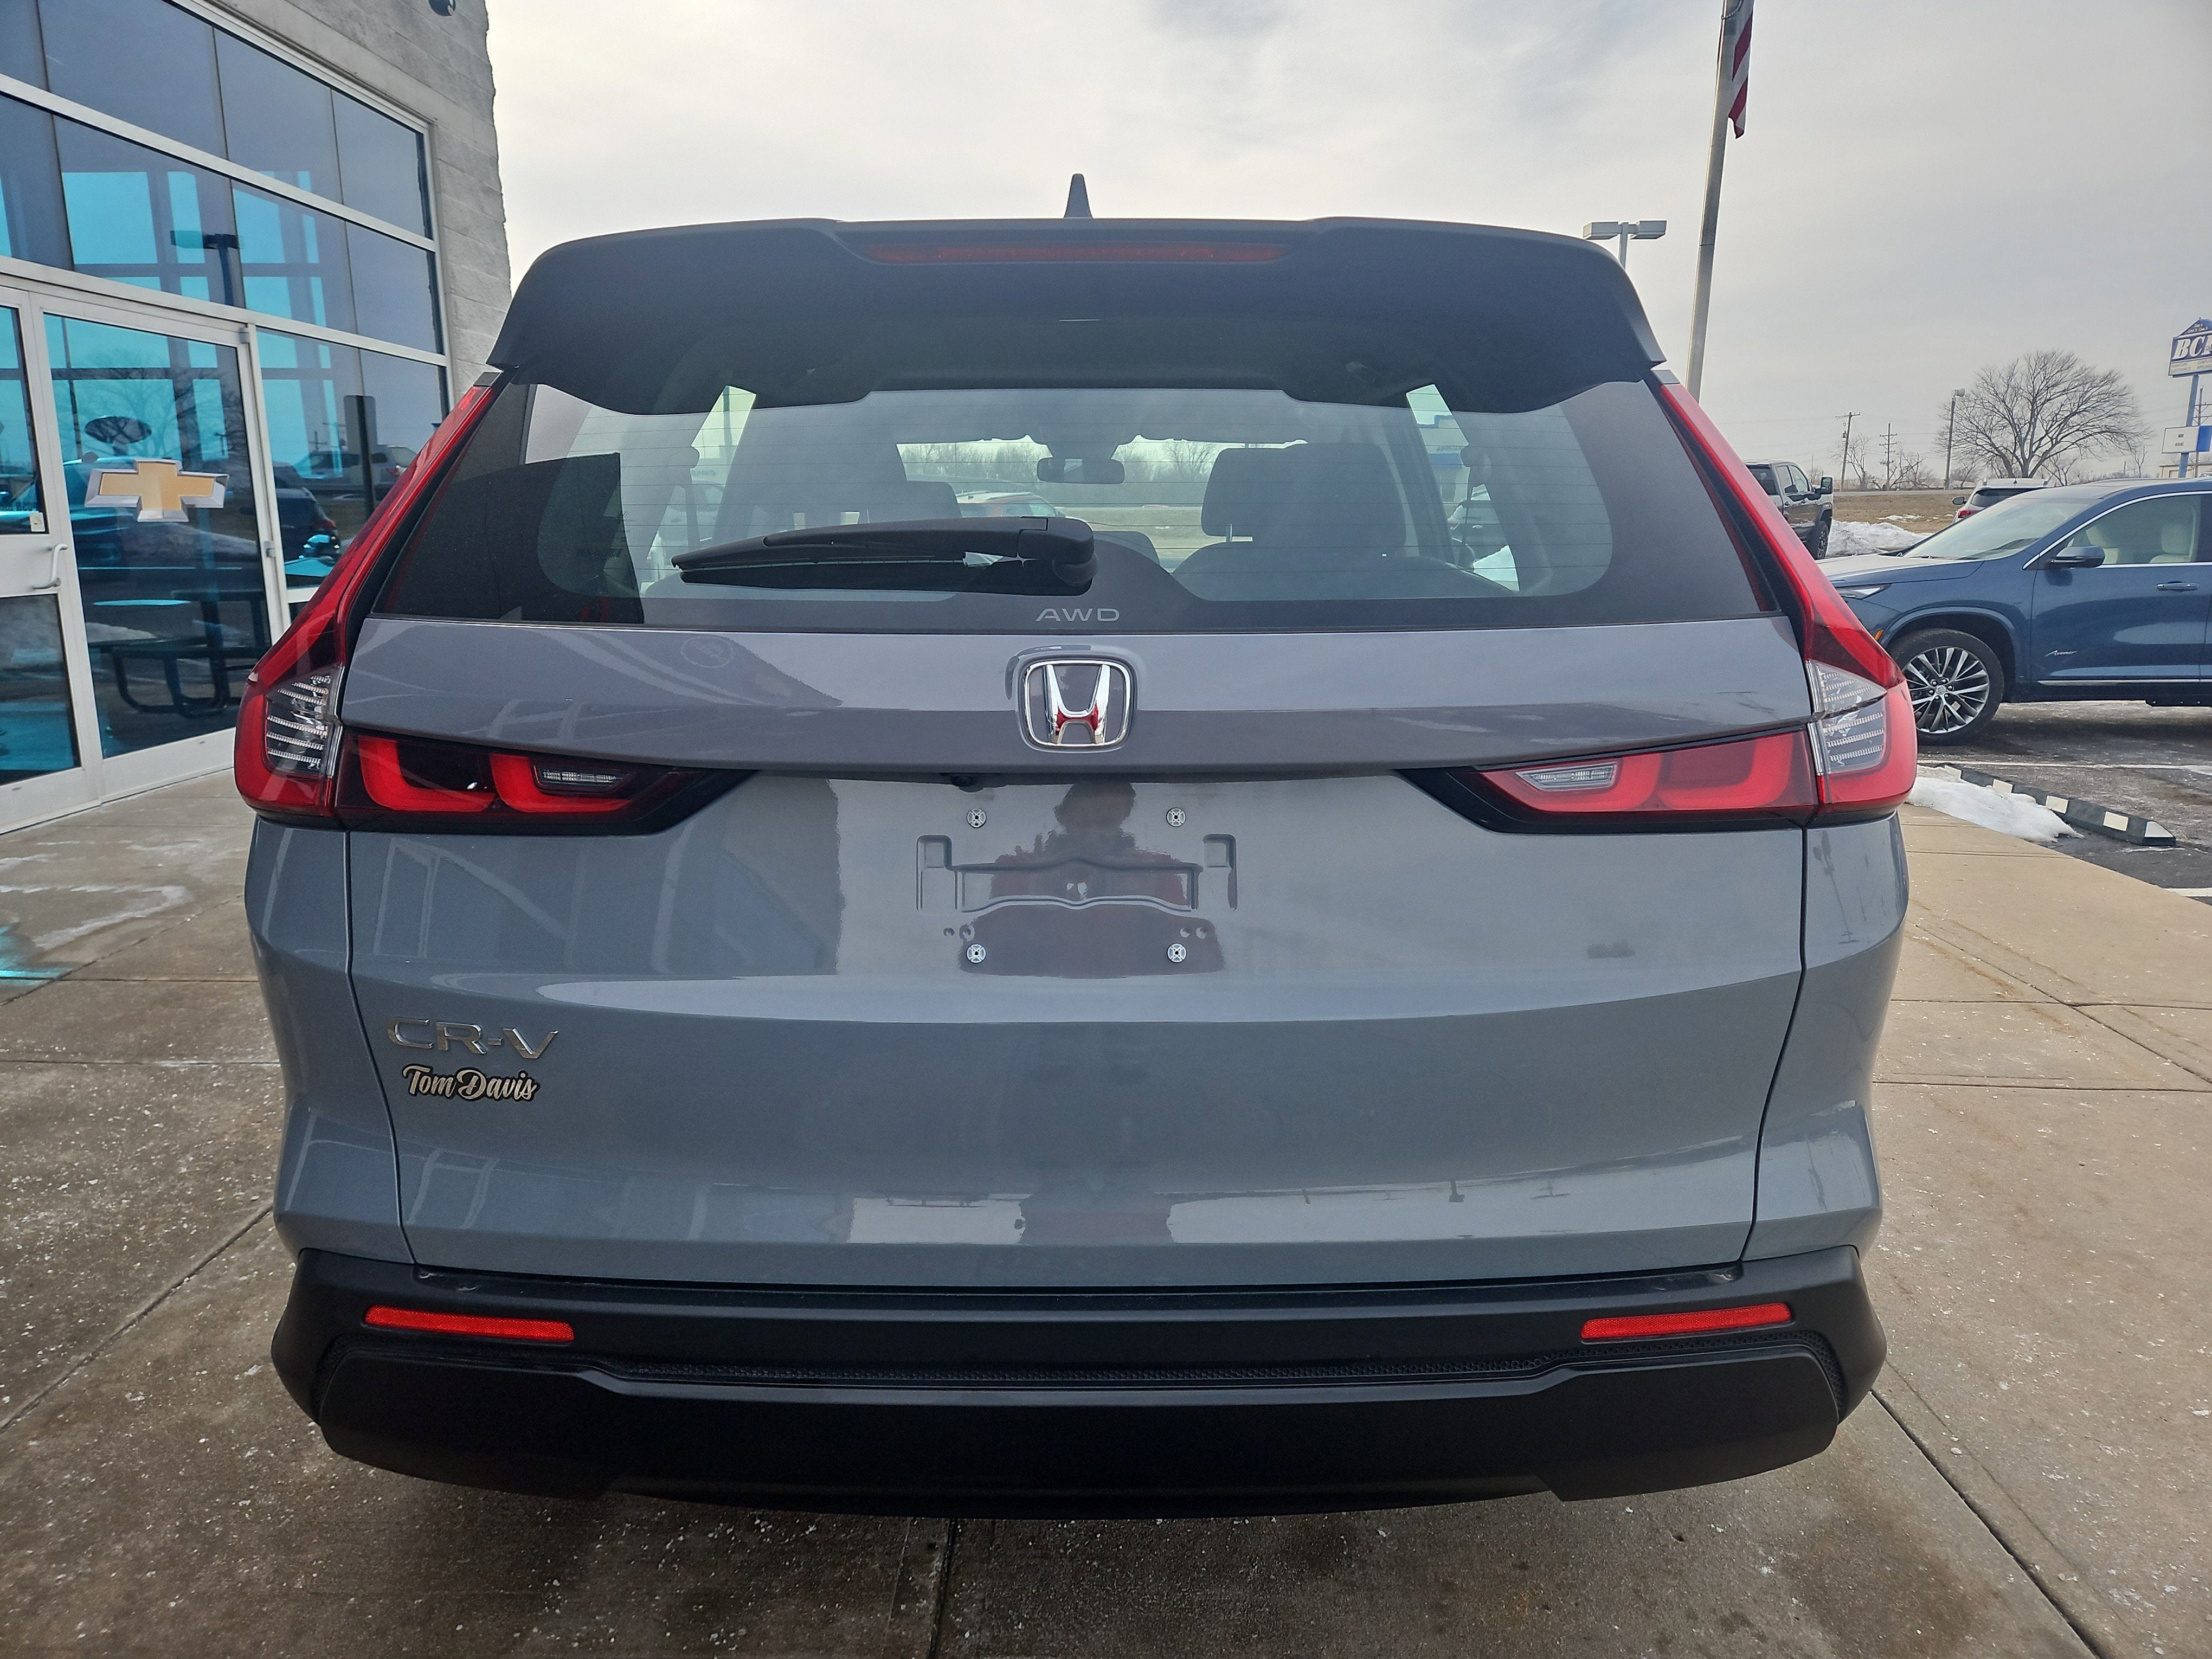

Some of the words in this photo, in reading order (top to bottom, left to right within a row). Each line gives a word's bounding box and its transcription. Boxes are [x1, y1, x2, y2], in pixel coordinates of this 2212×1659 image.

[1036, 608, 1120, 622] AWD
[387, 1017, 560, 1059] CR-V
[402, 1064, 457, 1098] Tom
[456, 1068, 539, 1101] Davis
